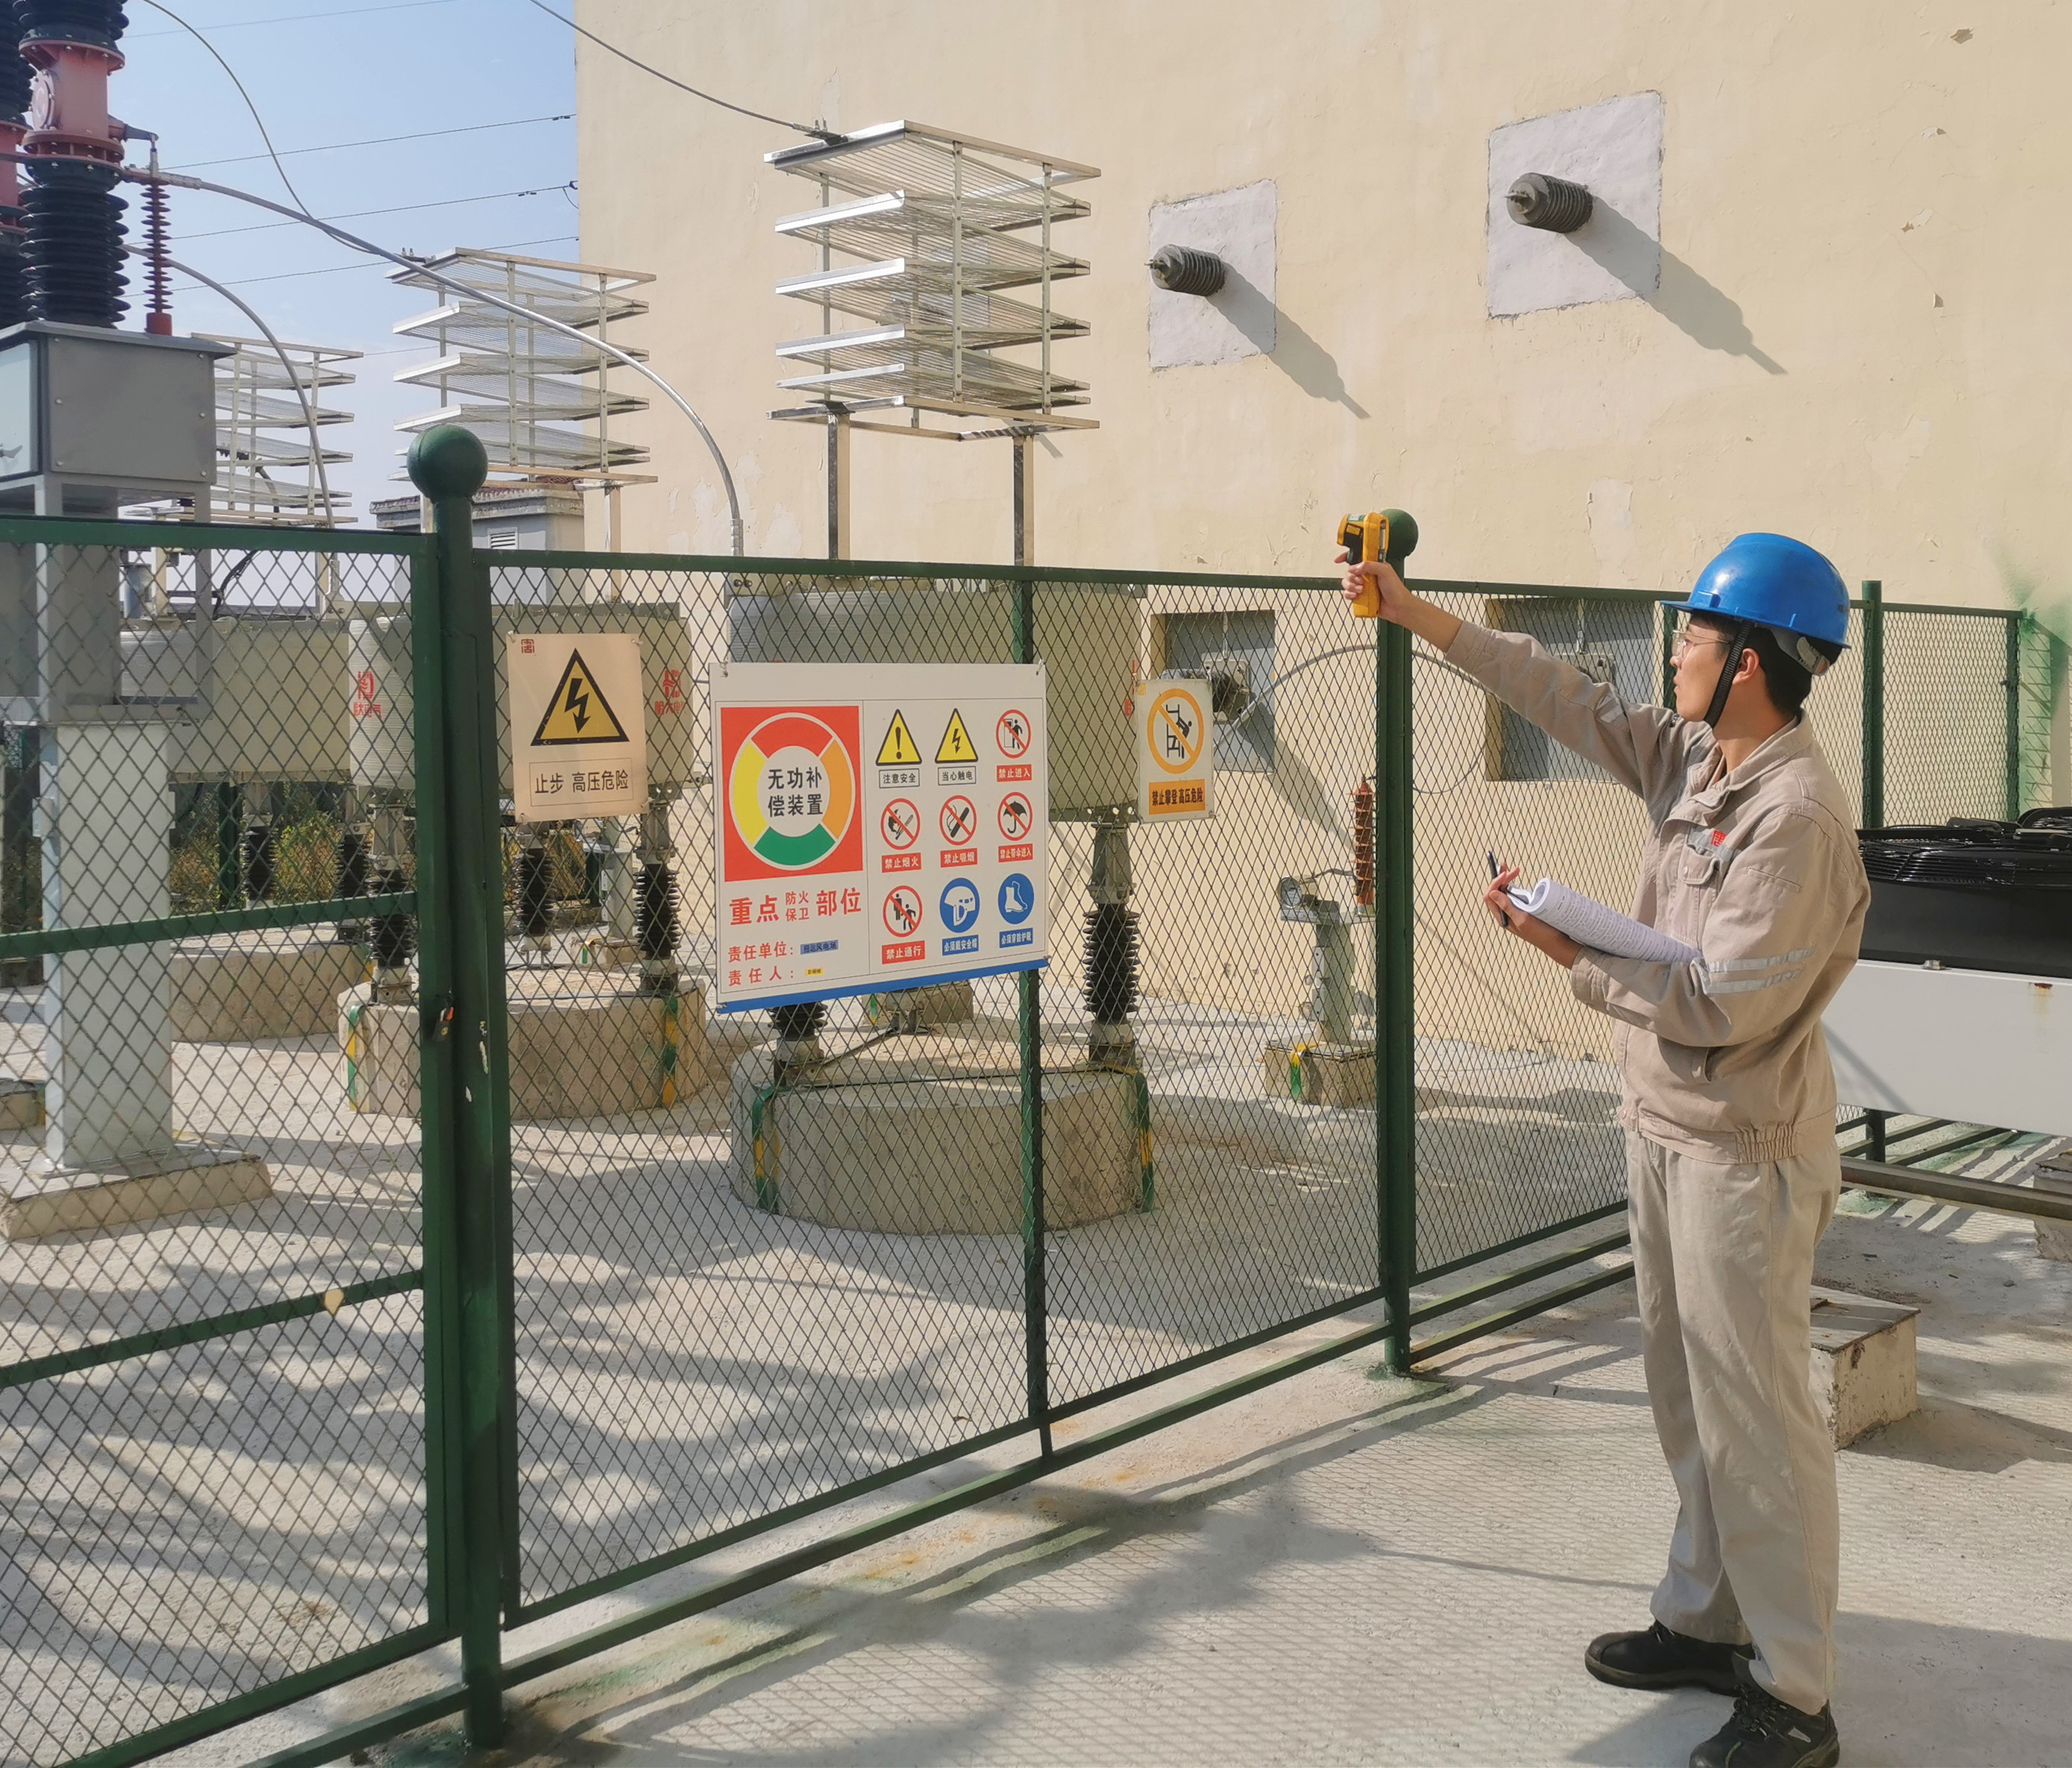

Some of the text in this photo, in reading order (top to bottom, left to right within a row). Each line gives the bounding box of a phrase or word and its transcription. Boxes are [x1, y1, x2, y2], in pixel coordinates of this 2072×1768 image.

[767, 766, 822, 790] 无功补
[883, 773, 917, 784] 注意安全
[942, 770, 973, 781] 当心触电
[998, 767, 1031, 779] 禁止进入
[535, 769, 629, 794] 止步 高压危险
[767, 793, 823, 818] 偿装置
[944, 852, 975, 865] 禁止吸烟
[999, 847, 1032, 859] 禁止带伞进入
[885, 856, 919, 869] 禁止烟火
[729, 887, 862, 926] 重点 防火 部位
[785, 907, 809, 922] 保卫
[886, 945, 922, 960] 禁止通行
